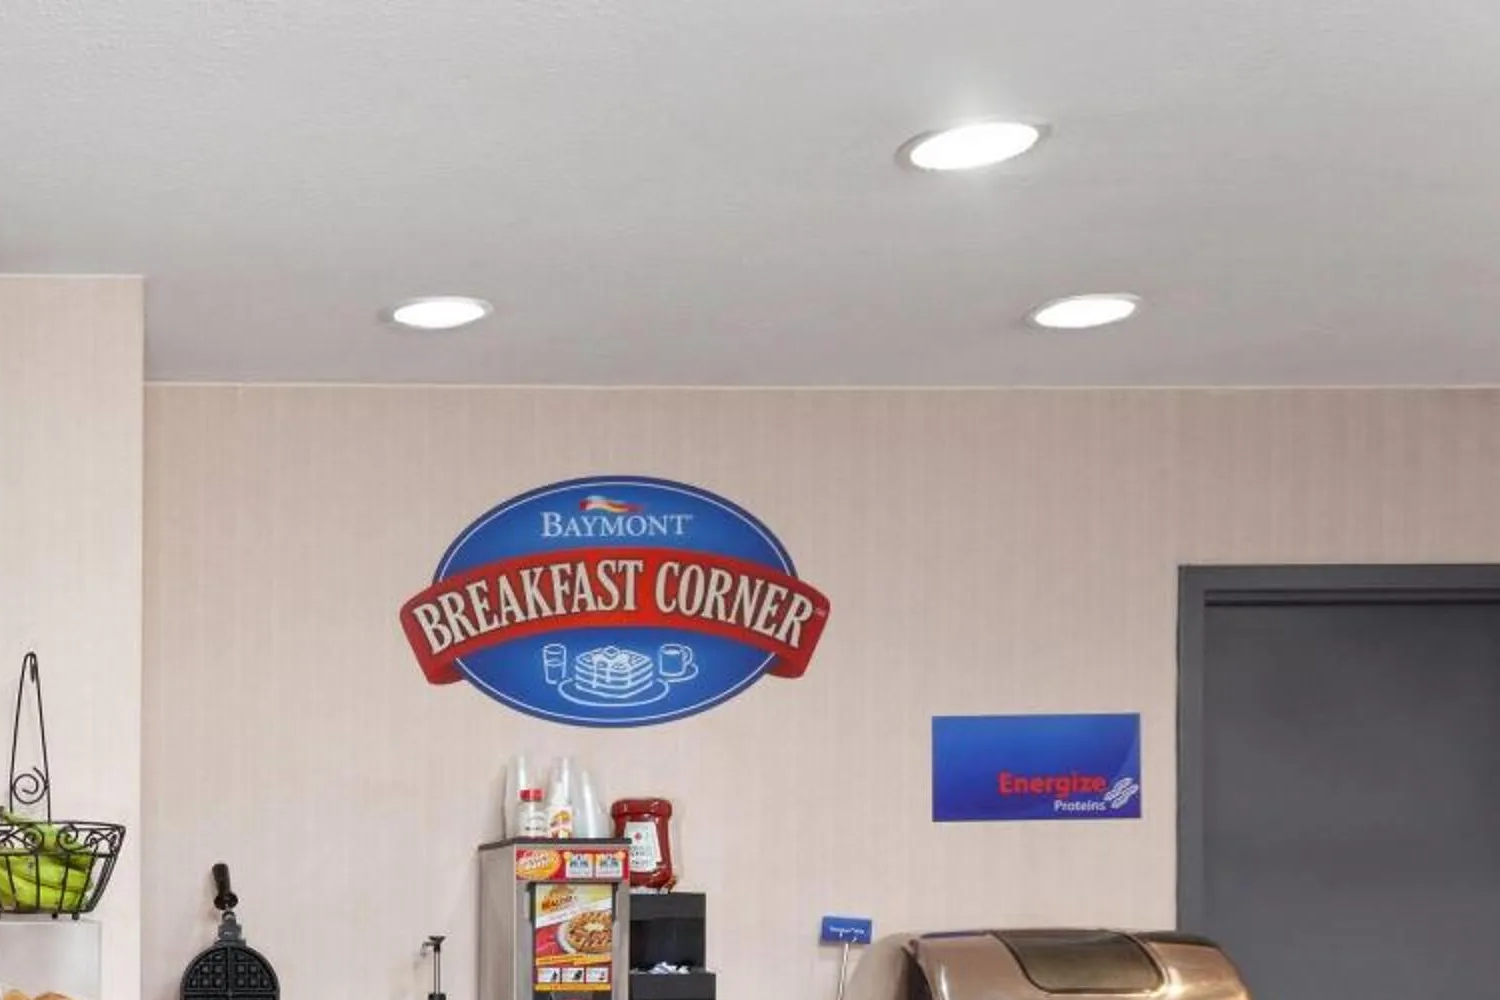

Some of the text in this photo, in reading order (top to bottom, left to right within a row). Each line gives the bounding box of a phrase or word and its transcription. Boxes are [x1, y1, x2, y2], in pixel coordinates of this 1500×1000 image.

[540, 512, 688, 538] BAYMONT
[412, 559, 814, 656] BREAKFAST CORNER
[998, 772, 1107, 798] Energize
[1054, 799, 1107, 811] Proteins
